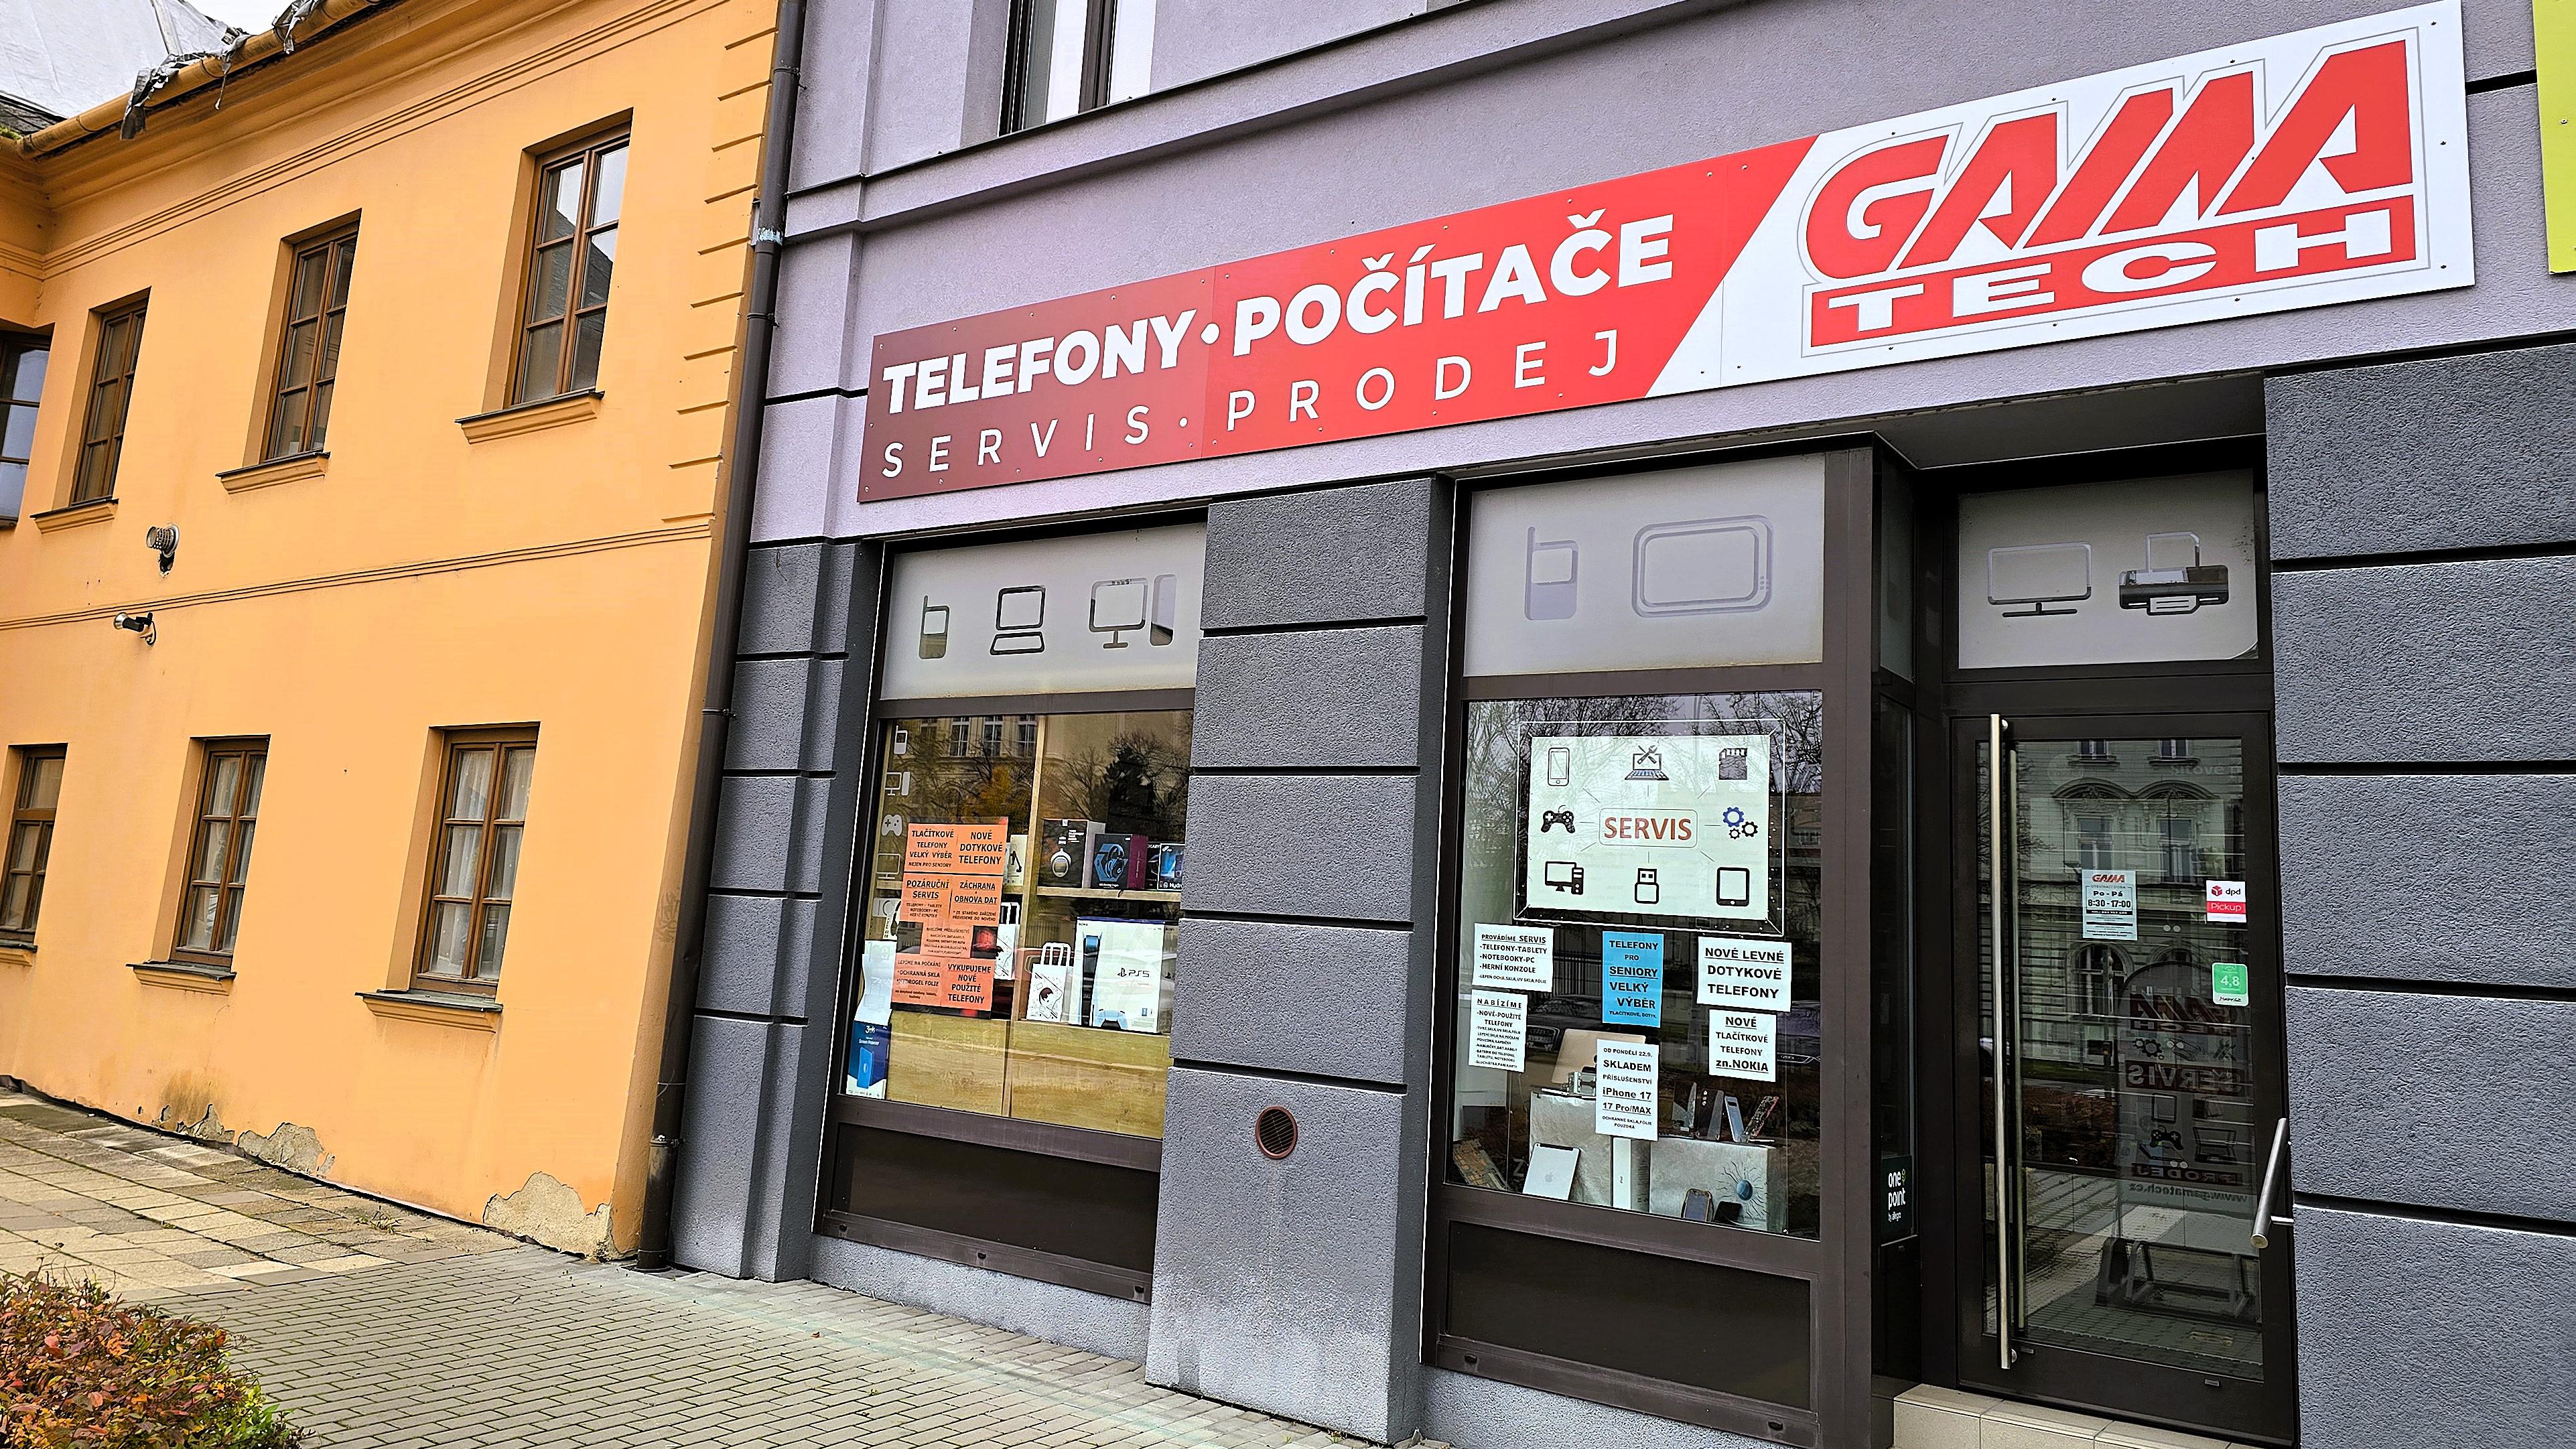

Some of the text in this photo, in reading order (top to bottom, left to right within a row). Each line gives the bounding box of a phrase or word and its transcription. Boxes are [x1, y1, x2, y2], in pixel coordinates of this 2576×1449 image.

[1806, 40, 2413, 279] GAMA
[1828, 208, 2392, 333] TECH
[882, 208, 1674, 414] TELEFONY POČÍTAČE
[882, 329, 1618, 478] SERVIS PRODEJ
[912, 828, 954, 838] TLAČÍTKOVÉ
[1604, 817, 1692, 841] SERVIS
[971, 830, 992, 840] NOVÉ
[959, 842, 1002, 852] DOTYKOVÉ
[910, 849, 952, 859] VELKÝ VÝBĚR
[959, 855, 1002, 864] TELEFONY
[906, 878, 949, 889] POZÁRUČNÍ
[2092, 874, 2125, 883] GAMA
[959, 880, 996, 890] ZÁCHRANA
[912, 891, 939, 899] SERVIS
[2226, 888, 2241, 896] dpd
[2088, 899, 2105, 907] 8:30
[2111, 900, 2131, 908] 17:00
[2211, 902, 2242, 912] Pickup
[1482, 934, 1546, 944] PROVÁDÍME SERVIS
[1609, 941, 1658, 950] TELEFONY
[1705, 947, 1784, 962] NOVÉ LEVNÉ
[948, 964, 991, 973] VYKUPUJEME
[1504, 965, 1536, 973] KONZOLE
[1609, 966, 1657, 977] SENIORY
[1707, 965, 1782, 980] DOTYKOVÉ
[958, 973, 976, 982] NOVÉ
[2220, 975, 2240, 987] 4,8
[951, 983, 981, 992] POUŽITÉ
[1609, 982, 1649, 992] VELKÝ
[1707, 983, 1779, 999] TELEFONY
[948, 993, 984, 1004] TELEFONY
[1477, 998, 1521, 1009] NABÍZÍME
[1617, 996, 1655, 1009] VÝBĚR
[1726, 1016, 1757, 1028] NOVÉ
[1716, 1032, 1768, 1043] TLAČÍTKOVÉ
[1720, 1046, 1763, 1056] TELEFONY
[1603, 1060, 1651, 1073] SKLADEM
[1716, 1060, 1768, 1072] zn.NOKIA
[1603, 1074, 1652, 1085] PŘÍSLUŠENSTVÍ
[1603, 1087, 1651, 1100] iPhone 17
[1615, 1103, 1651, 1115] Pro/MAX
[1889, 1172, 1901, 1187] one
[1889, 1188, 1905, 1211] point
